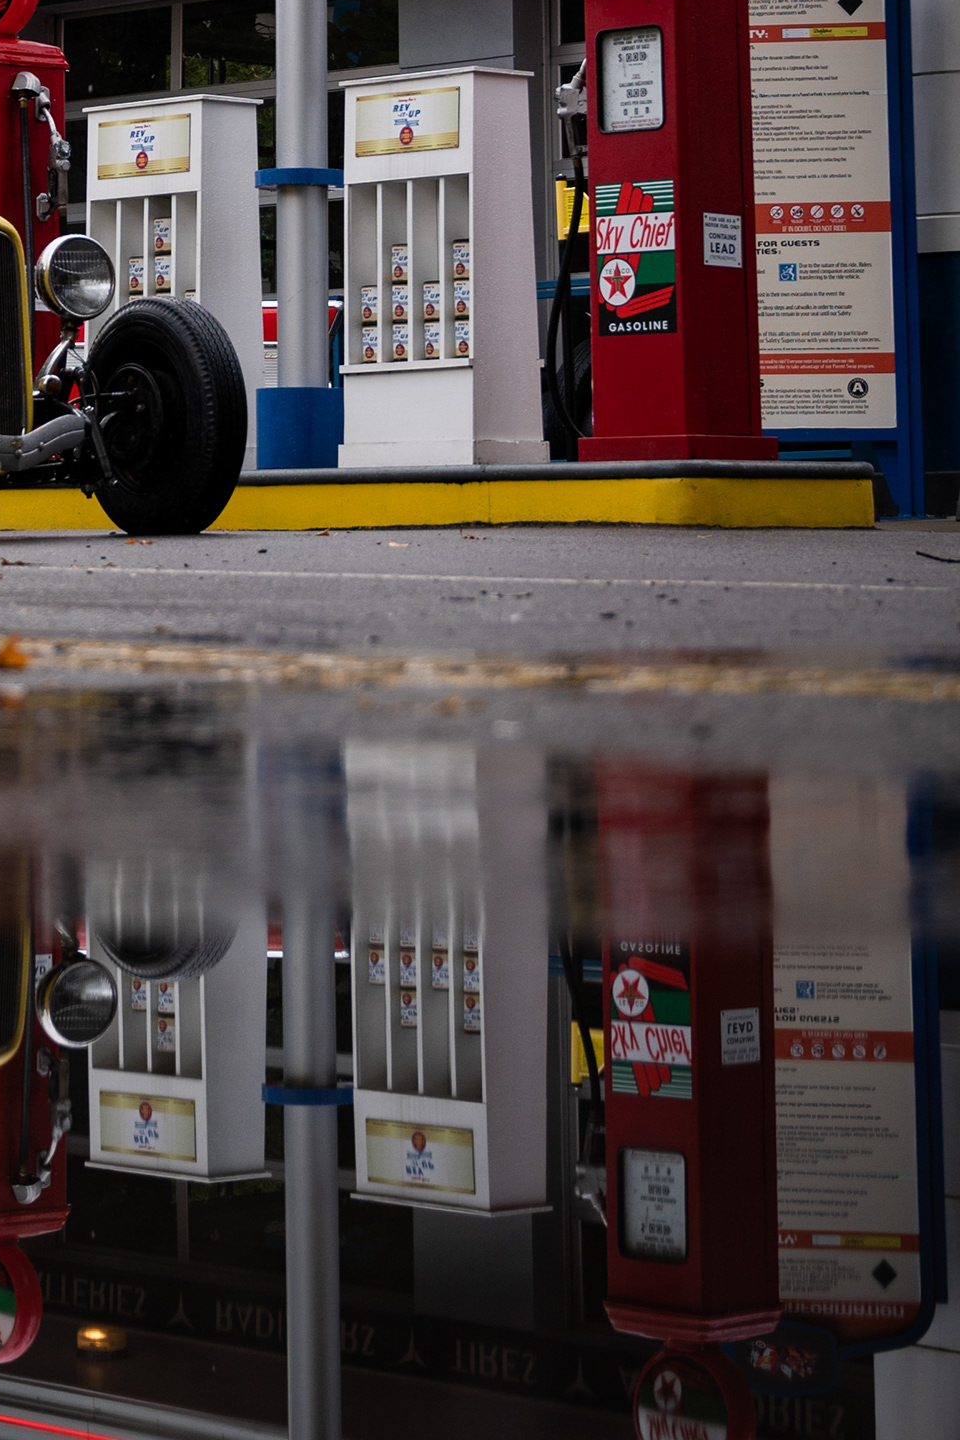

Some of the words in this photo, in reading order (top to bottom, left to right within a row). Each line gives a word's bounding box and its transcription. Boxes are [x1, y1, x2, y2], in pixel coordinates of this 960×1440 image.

[749, 29, 769, 39] TY:
[392, 103, 411, 113] REV
[408, 109, 421, 118] UP
[130, 129, 146, 139] REV
[143, 135, 155, 143] UP
[596, 218, 624, 252] Sky
[629, 214, 675, 249] Chief
[708, 232, 737, 241] CONTAINS
[710, 242, 736, 254] LEAD
[605, 267, 631, 275] TEXACO
[608, 320, 669, 333] GASOLINE
